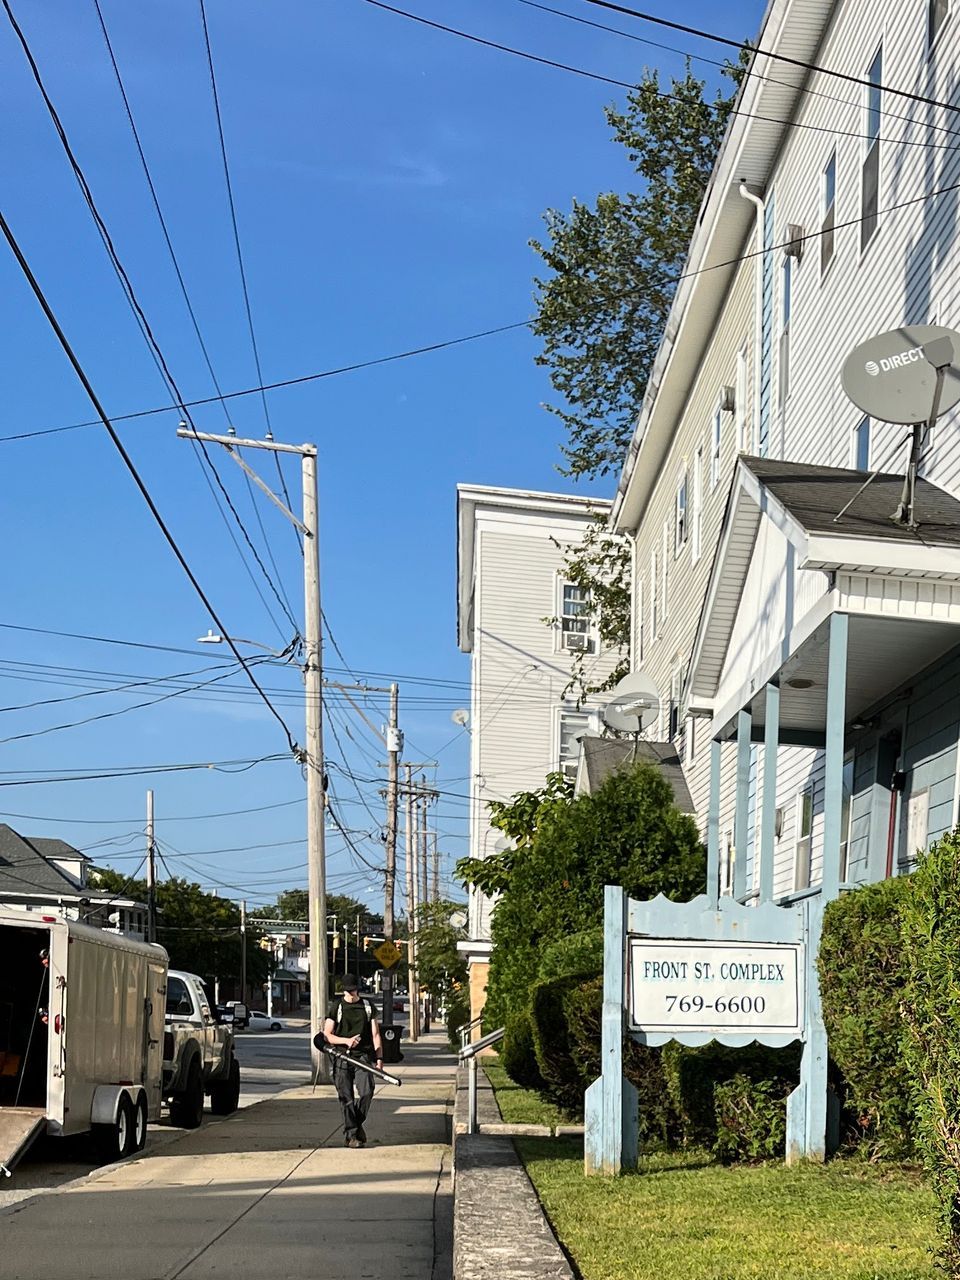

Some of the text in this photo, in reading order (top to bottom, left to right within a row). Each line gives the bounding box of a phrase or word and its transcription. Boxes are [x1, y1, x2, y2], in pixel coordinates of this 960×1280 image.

[644, 961, 785, 981] FRONT ST. COMPLEX
[665, 995, 766, 1013] 769-6600
